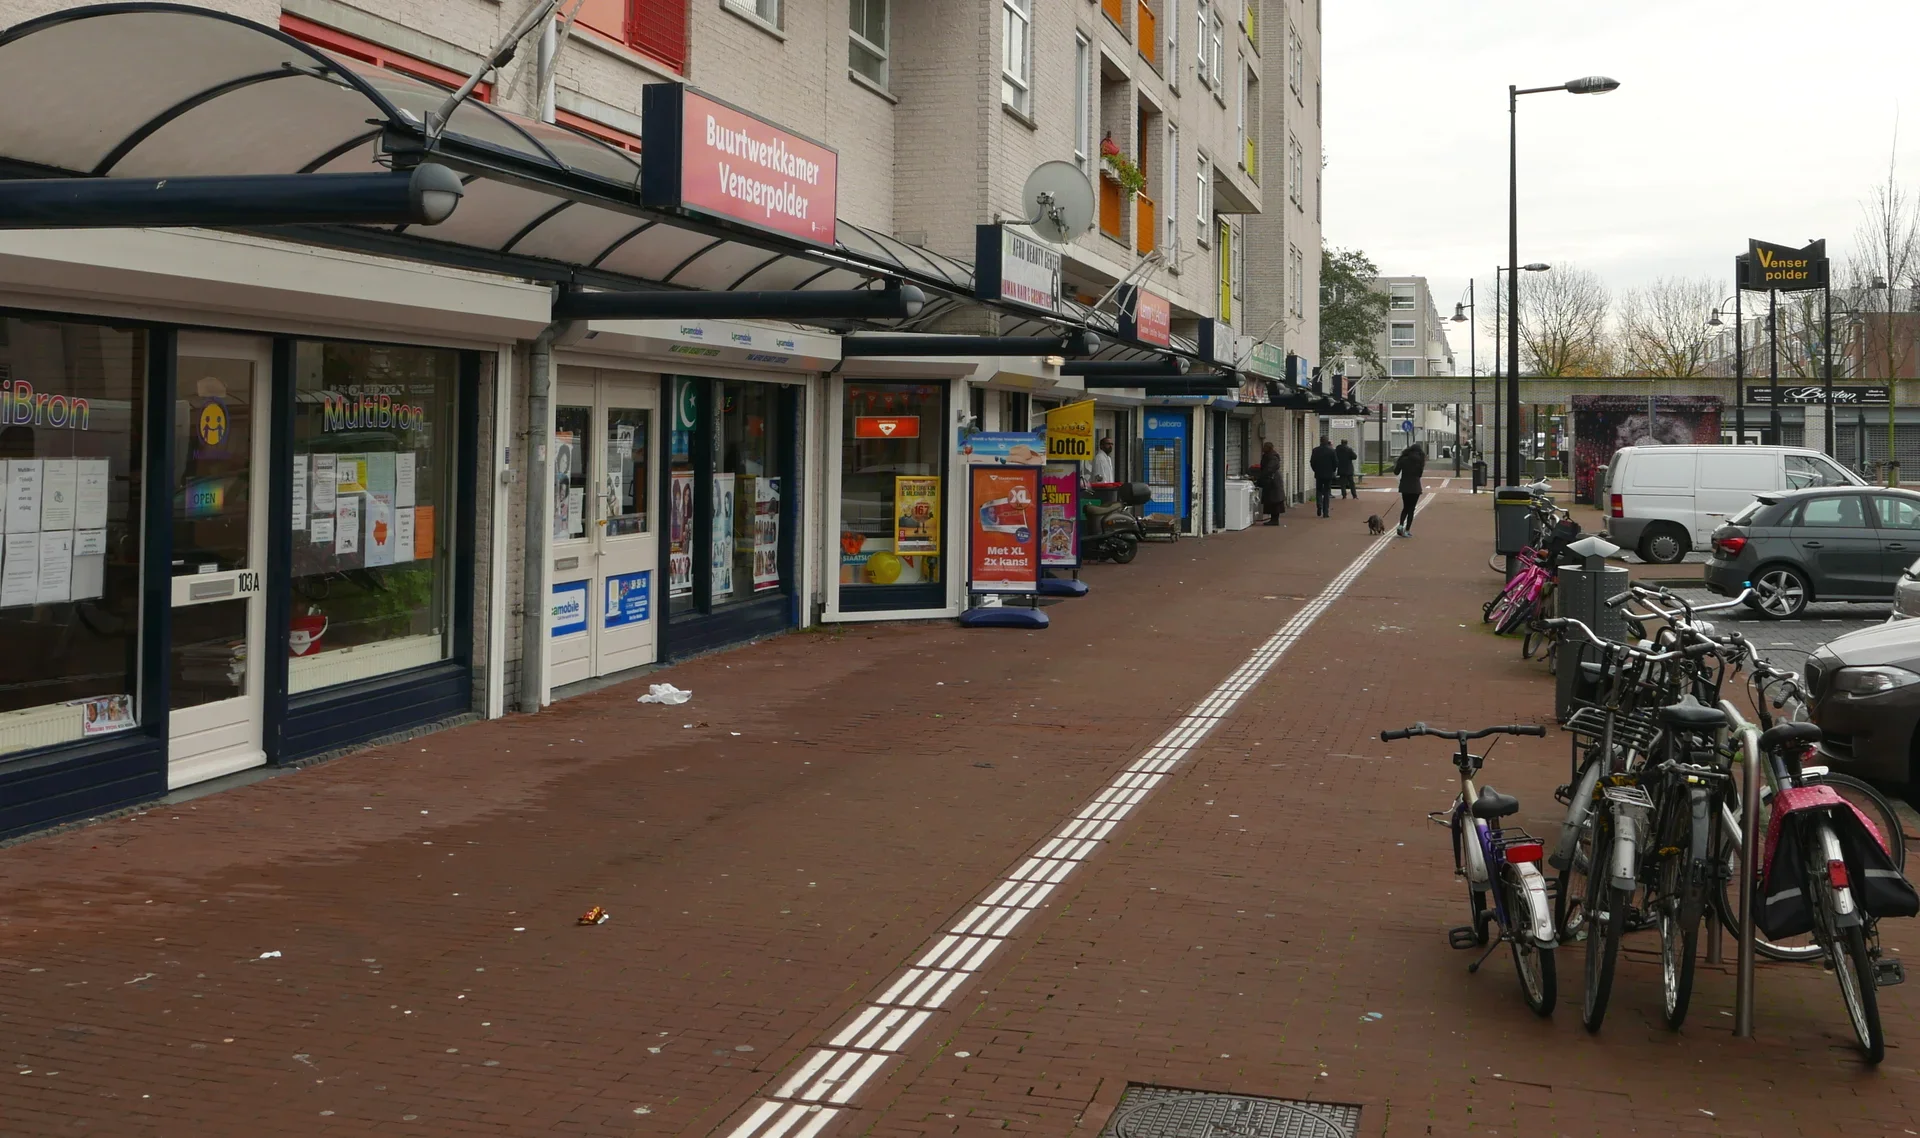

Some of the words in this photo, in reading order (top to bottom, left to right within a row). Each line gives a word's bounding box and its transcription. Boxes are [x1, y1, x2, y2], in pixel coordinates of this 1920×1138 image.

[706, 114, 819, 185] Buurtwerkkamer
[718, 161, 809, 219] Venserpolder
[1013, 237, 1025, 260] AFRO
[1027, 243, 1043, 267] BEAUTY
[1756, 247, 1808, 268] Venser
[1765, 269, 1808, 281] polder
[680, 325, 703, 336] Lycamobile
[731, 332, 752, 343] Lycamobile
[776, 338, 794, 348] Lycamobile
[324, 391, 424, 432] MultiBron
[1158, 419, 1182, 428] Lebara
[1049, 437, 1091, 456] Lotto.
[193, 492, 216, 505] OPEN
[1010, 489, 1031, 504] XL
[1049, 493, 1071, 504] SINT
[914, 505, 930, 516] 167
[987, 546, 1009, 555] Met
[1010, 546, 1025, 555] XL
[984, 558, 997, 566] 2x
[999, 557, 1028, 567] kans!
[551, 600, 580, 616] amobile
